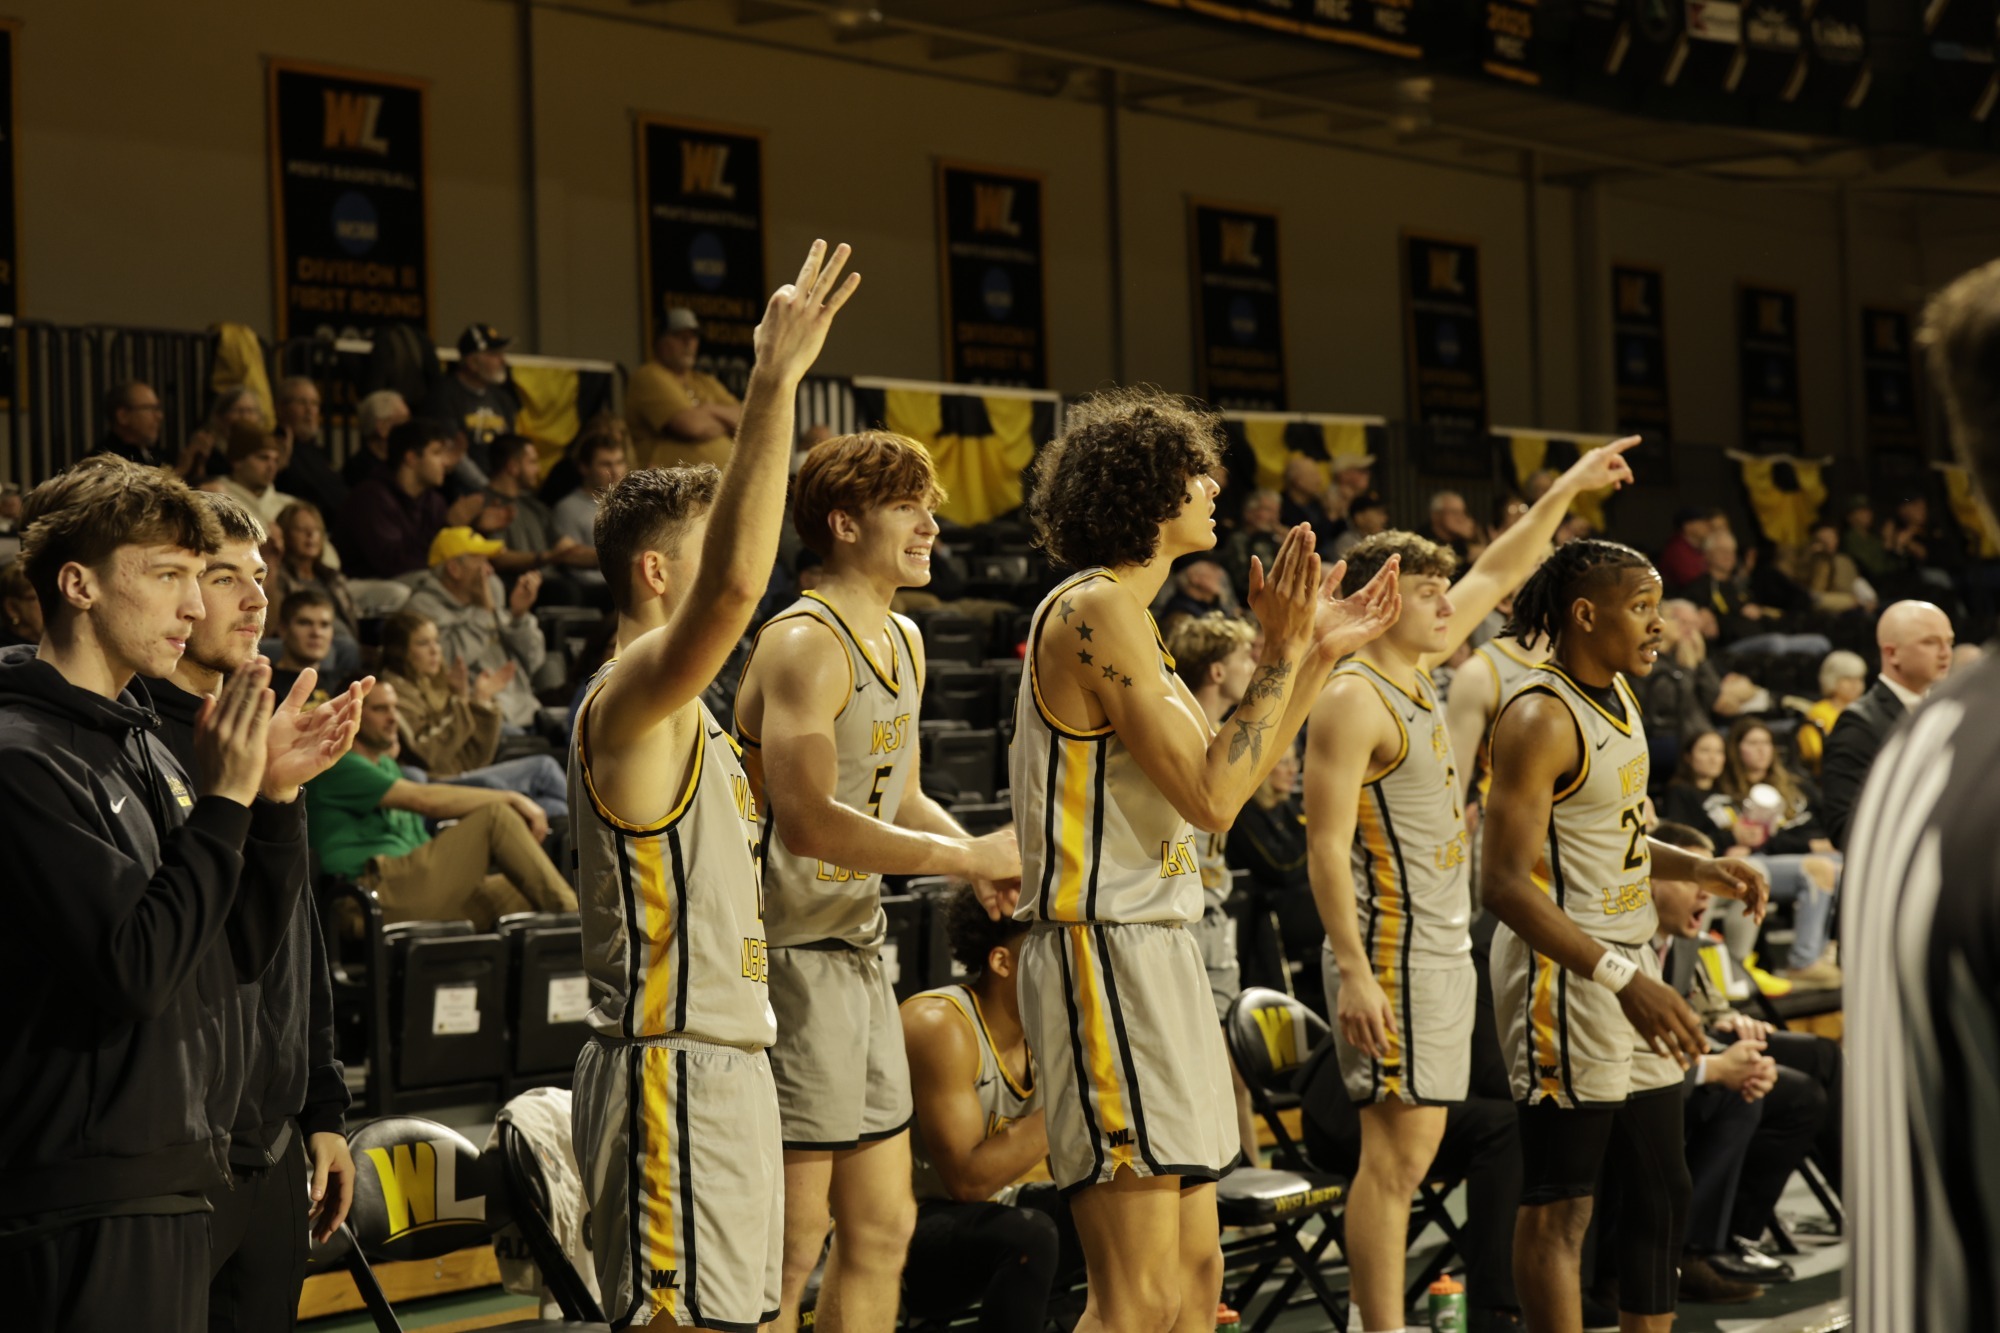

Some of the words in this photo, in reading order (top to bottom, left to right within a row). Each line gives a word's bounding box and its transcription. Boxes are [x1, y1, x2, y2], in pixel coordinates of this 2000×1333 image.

[321, 86, 391, 158] WL
[680, 139, 737, 201] WL
[297, 256, 397, 289] DIVISION
[351, 289, 423, 319] ROUND
[870, 713, 910, 755] WEST
[1106, 1127, 1135, 1147] WL
[362, 1138, 487, 1236] WL
[650, 1269, 681, 1289] WL
